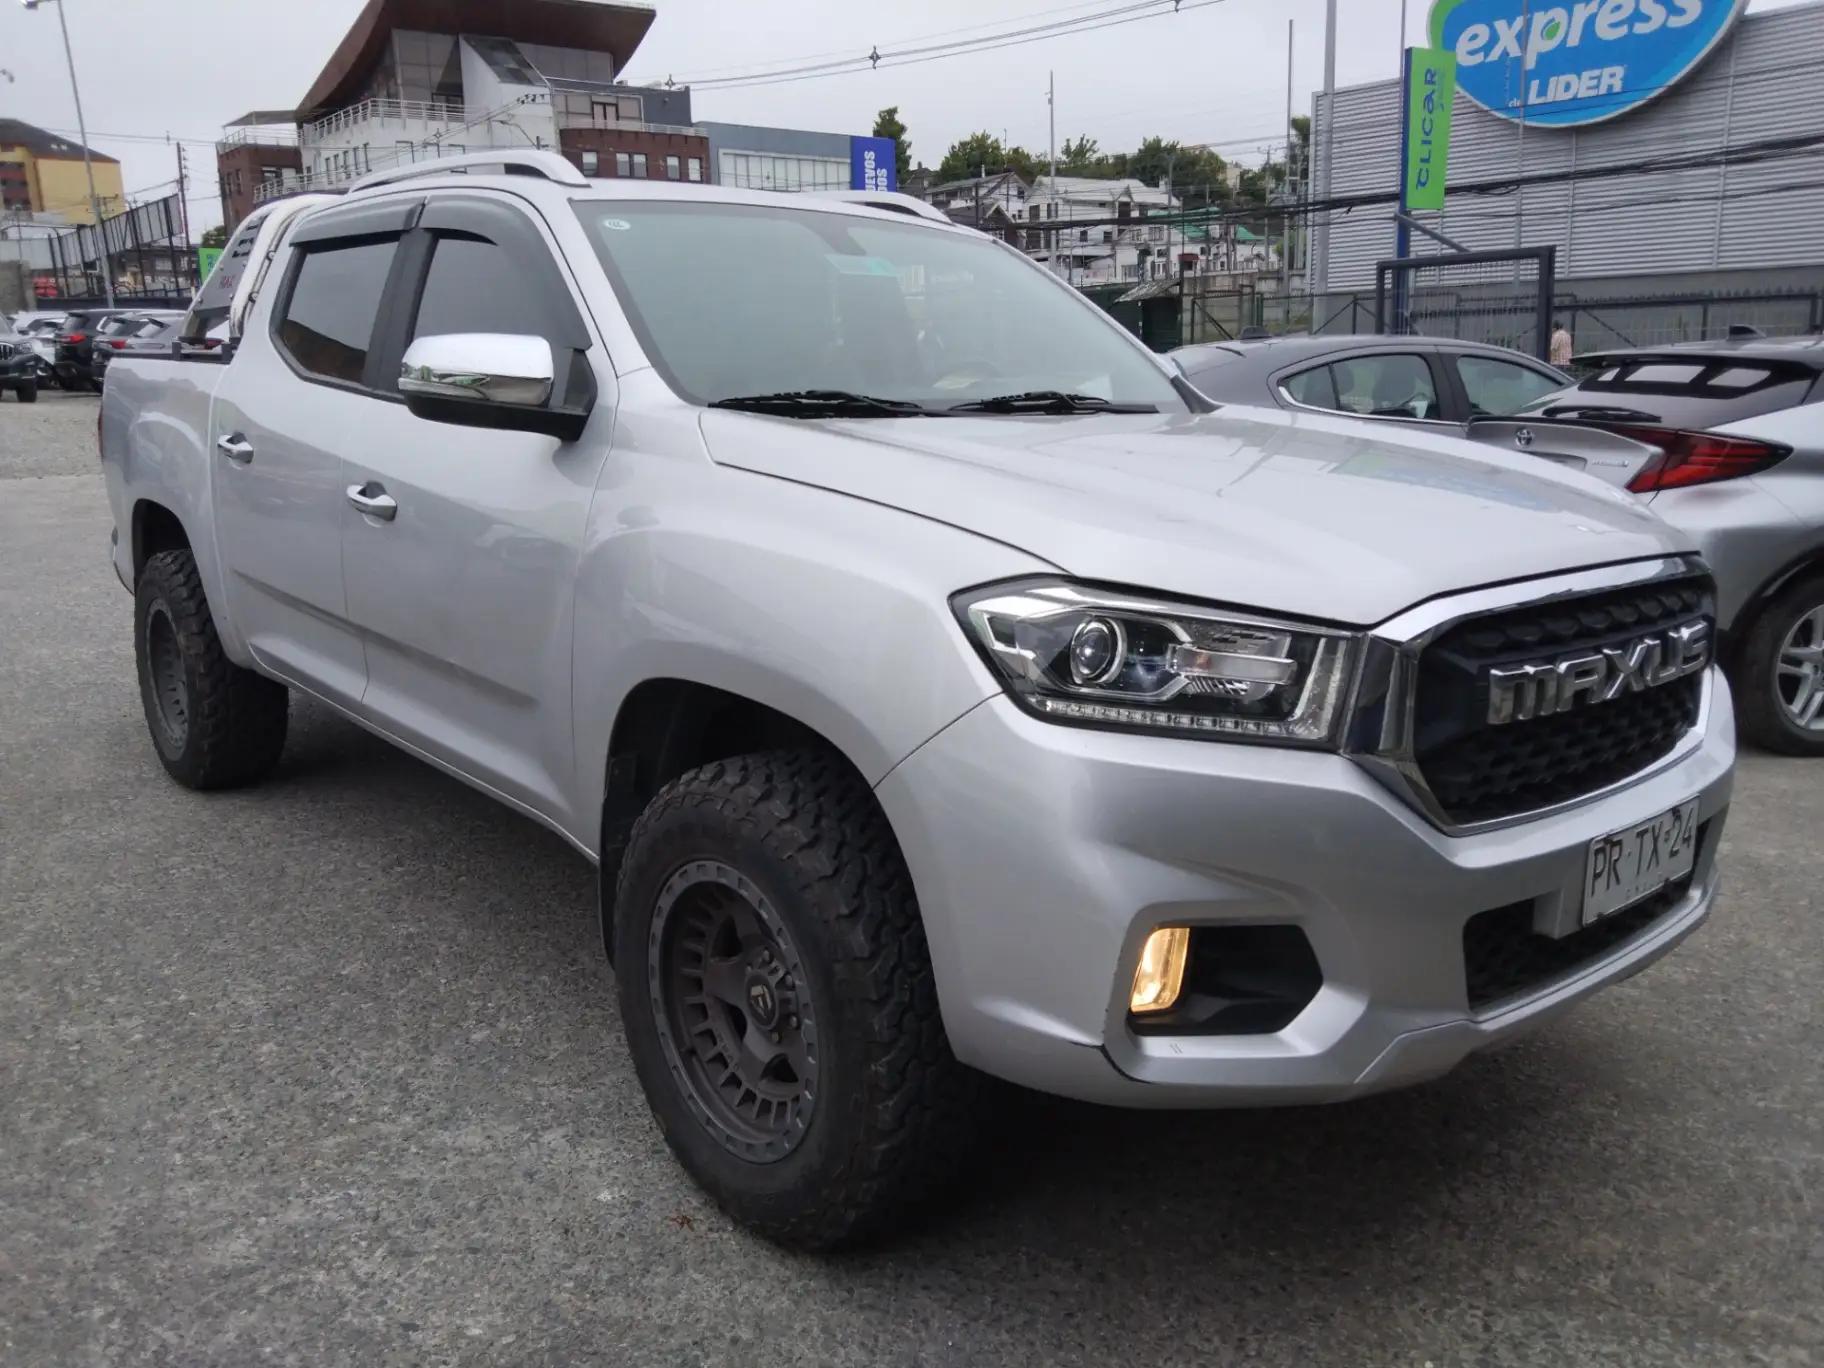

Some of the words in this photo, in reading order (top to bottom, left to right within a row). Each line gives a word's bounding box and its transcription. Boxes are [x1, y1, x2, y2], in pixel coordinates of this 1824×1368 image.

[1455, 0, 1702, 70] express
[1527, 65, 1624, 105] LIDER
[1416, 68, 1437, 190] CLICAR
[1487, 620, 1708, 725] MAXUS
